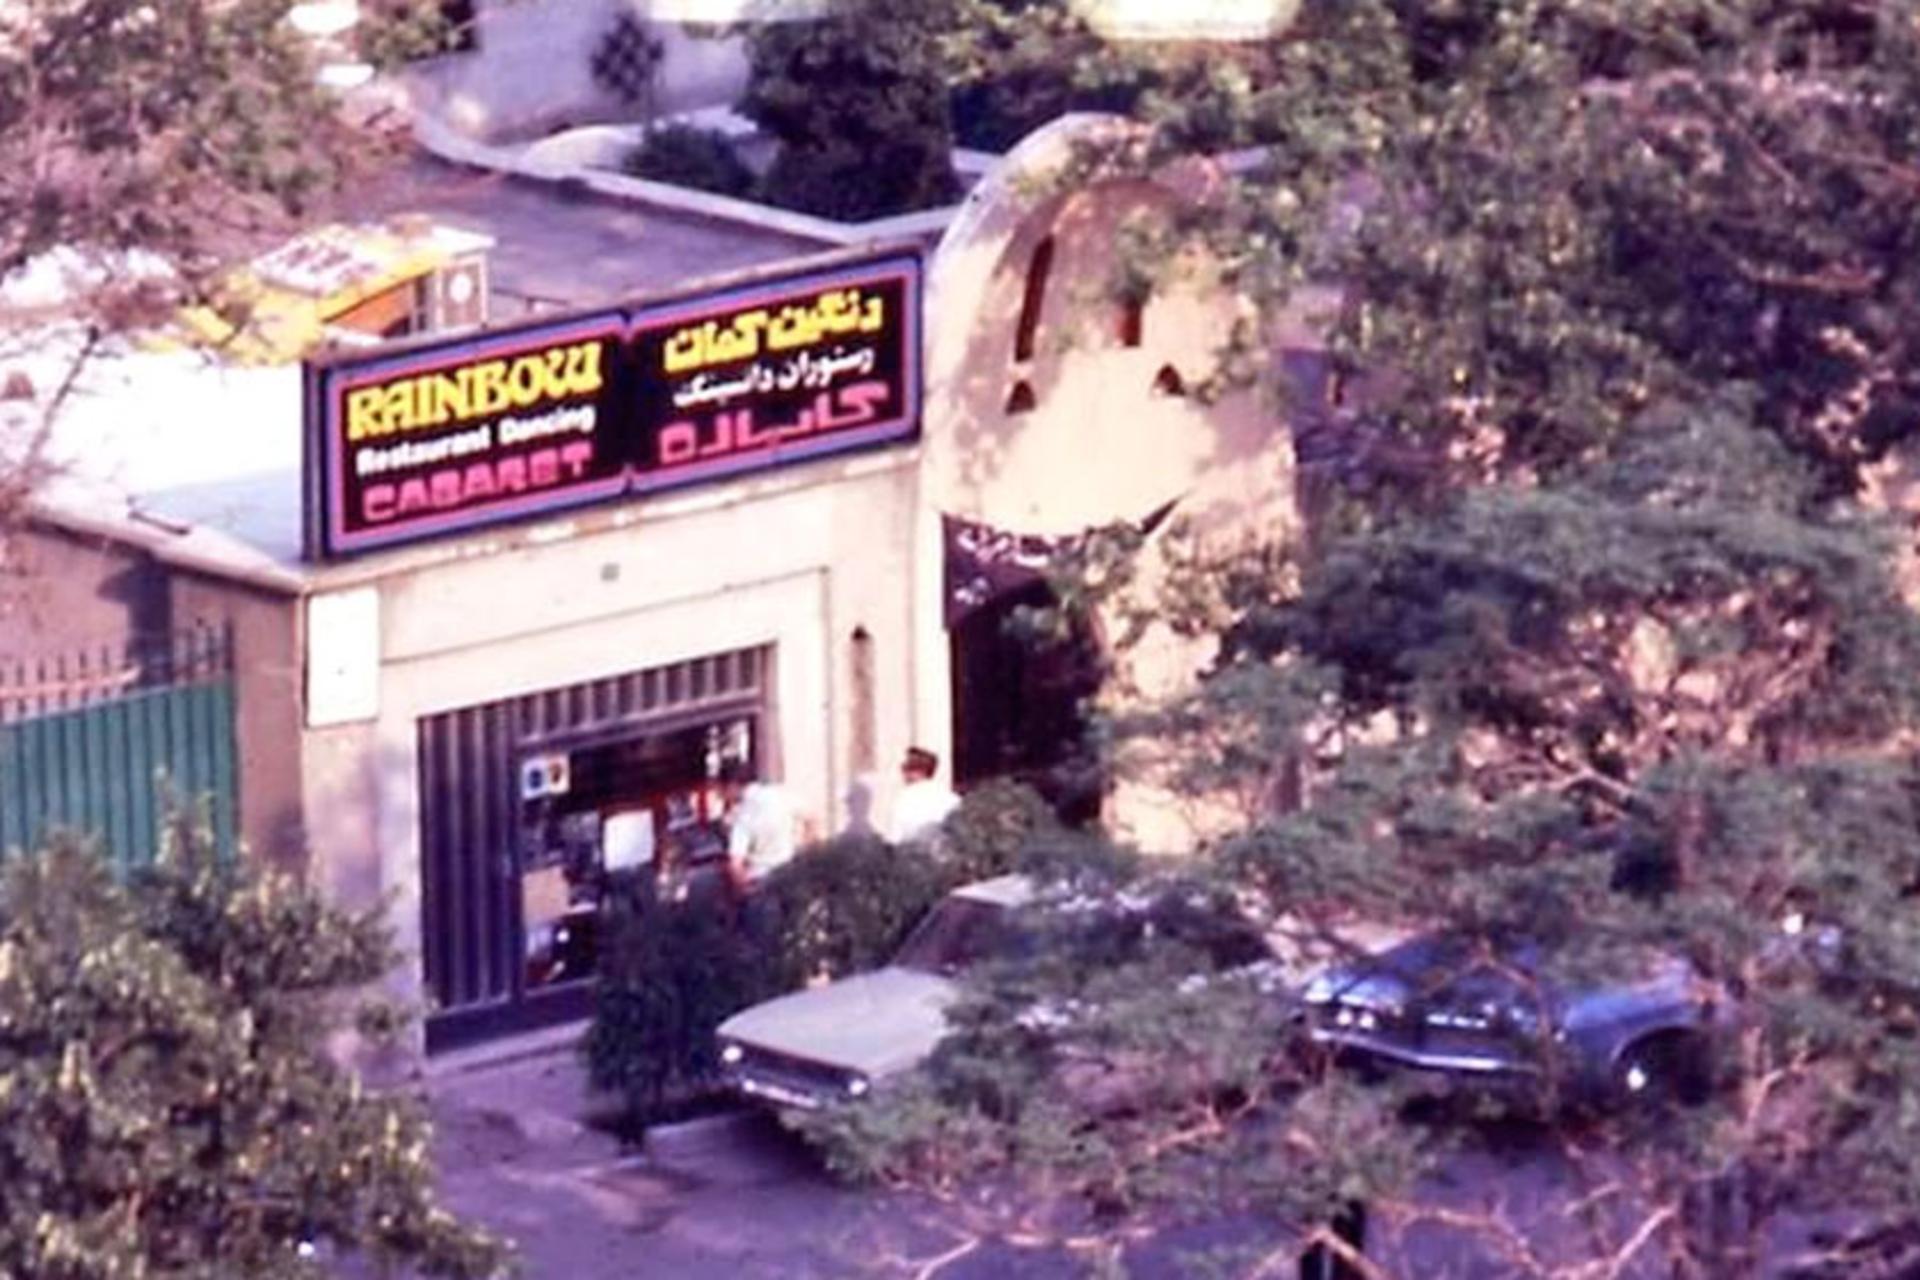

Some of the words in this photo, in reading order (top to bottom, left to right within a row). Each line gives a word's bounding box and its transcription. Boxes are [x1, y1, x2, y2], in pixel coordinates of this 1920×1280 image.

[663, 310, 767, 373] کمان
[777, 344, 875, 391] رستوران
[347, 342, 603, 440] RAINBOW
[659, 381, 890, 465] کاباره
[356, 423, 491, 475] Restaurant
[498, 404, 596, 446] Dancing
[361, 441, 593, 521] CABARET
